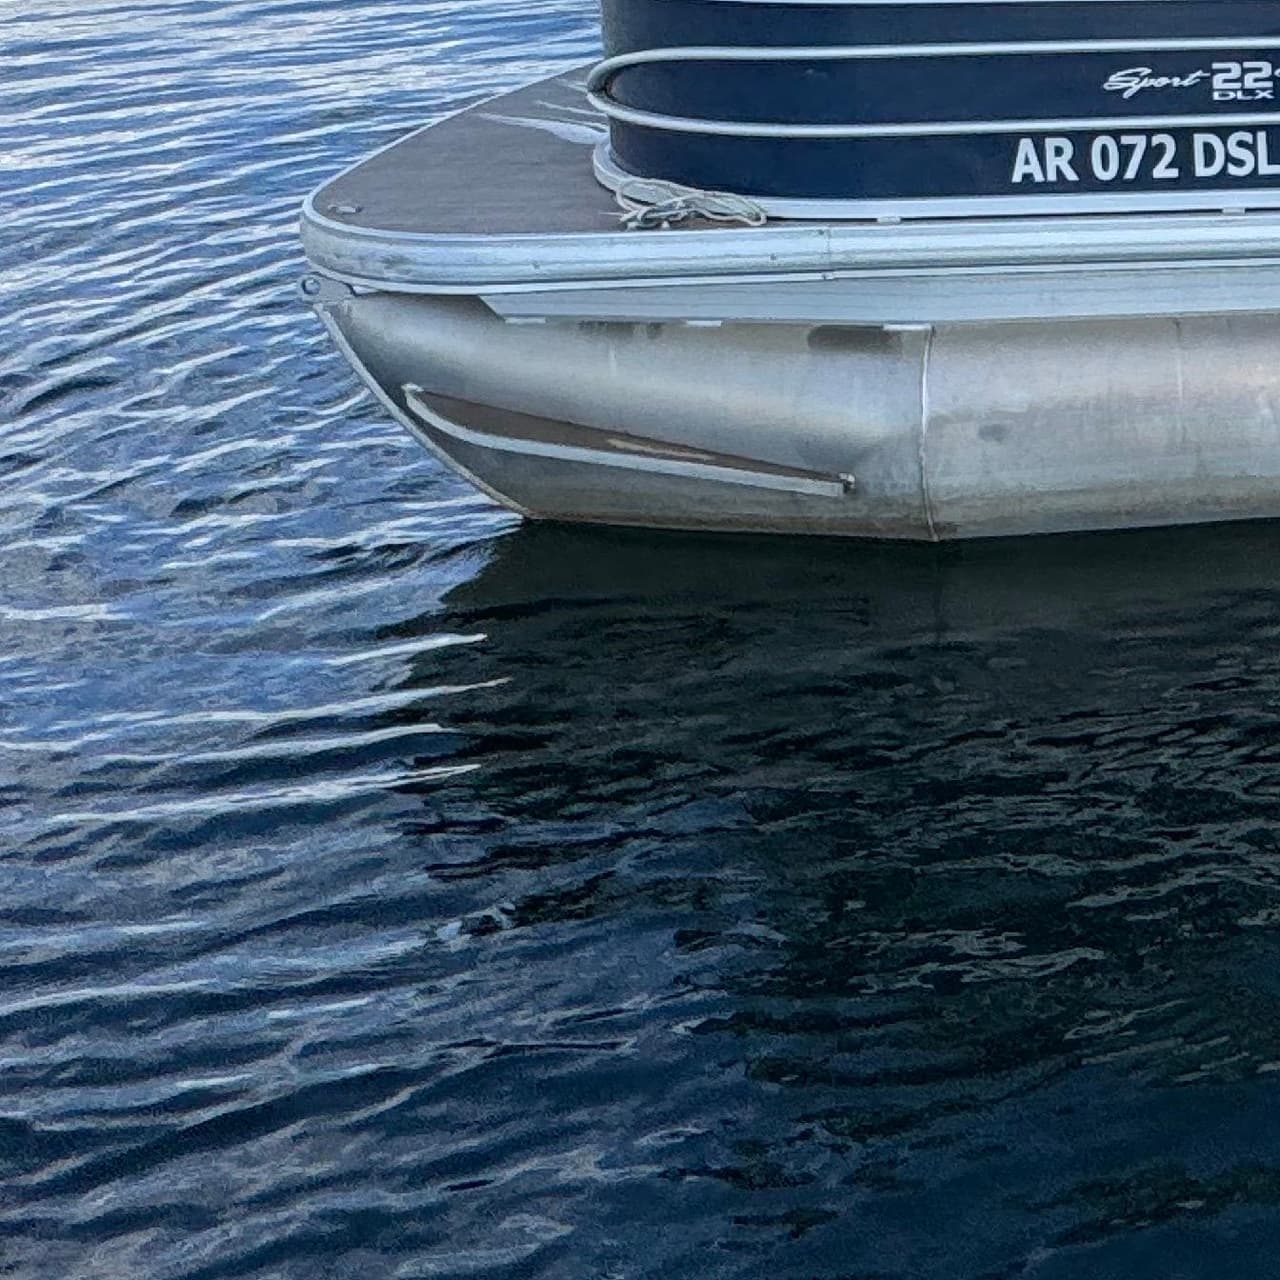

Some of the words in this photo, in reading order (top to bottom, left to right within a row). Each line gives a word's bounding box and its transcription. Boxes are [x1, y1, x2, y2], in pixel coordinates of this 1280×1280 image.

[1103, 67, 1210, 99] Sport
[1211, 61, 1273, 89] 22
[1212, 90, 1275, 101] DLX
[1011, 137, 1079, 183] AR
[1090, 133, 1180, 181] 072
